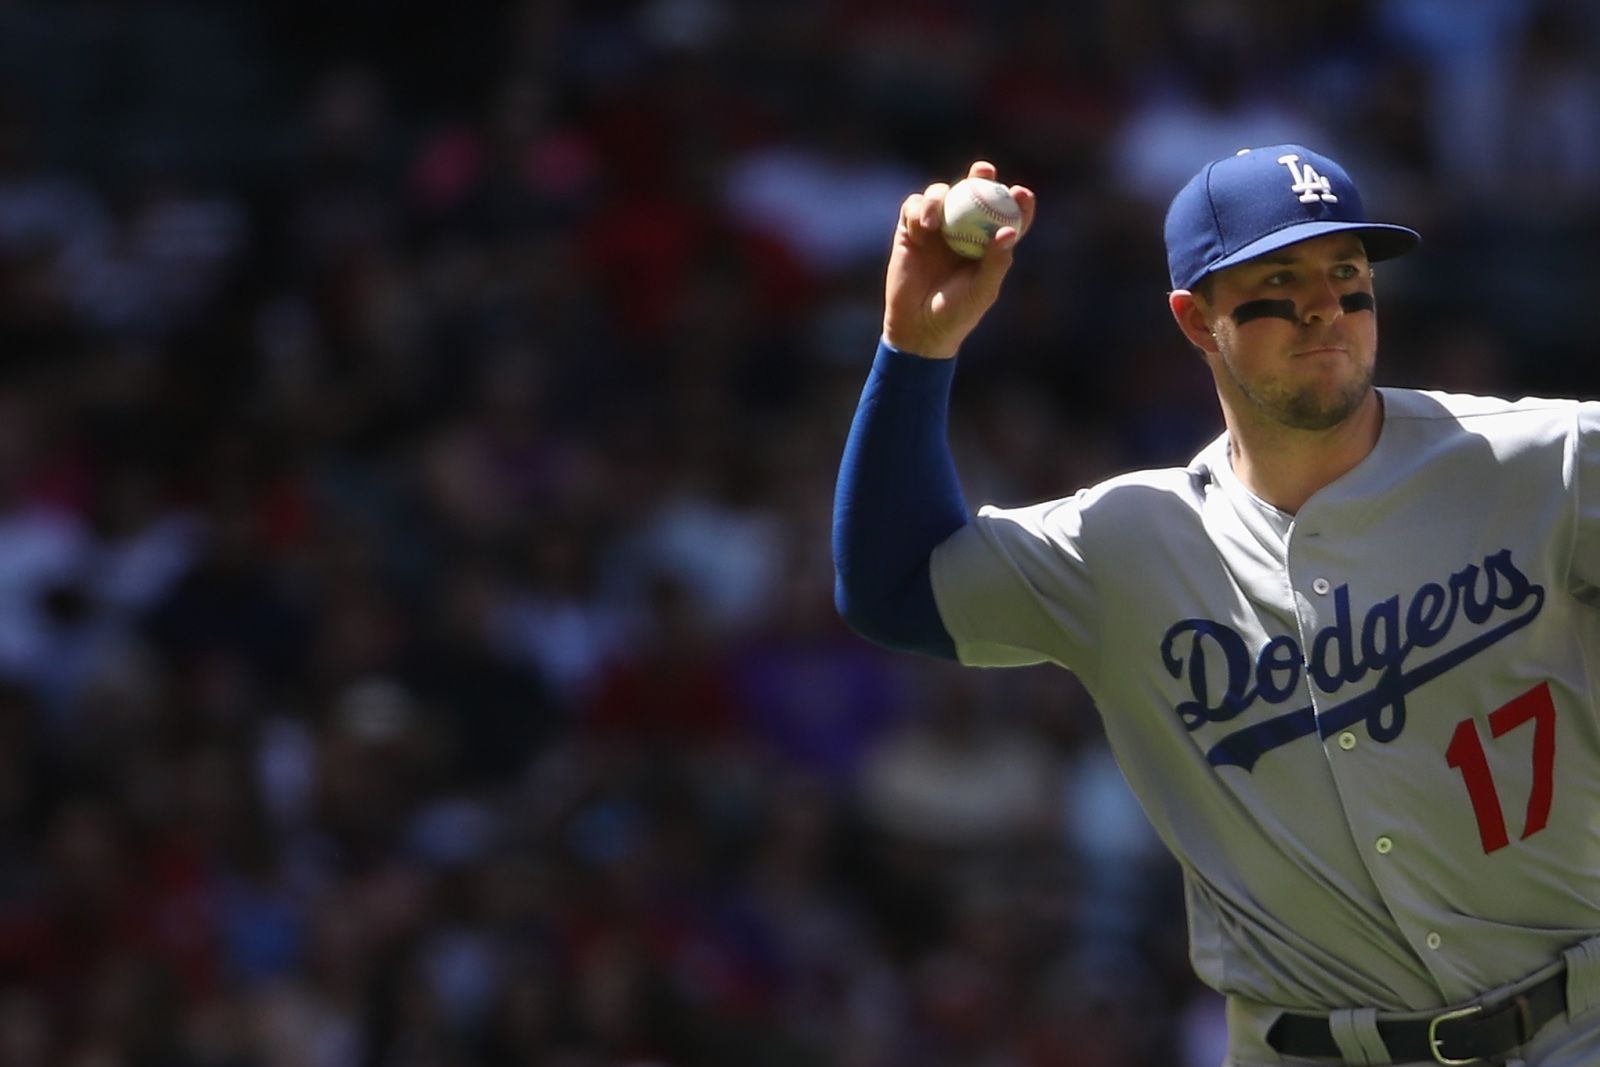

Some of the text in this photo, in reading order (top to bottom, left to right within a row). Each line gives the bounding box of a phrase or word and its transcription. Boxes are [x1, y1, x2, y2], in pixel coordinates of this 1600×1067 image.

[1277, 154, 1339, 204] LA
[1160, 548, 1544, 744] Dodgers
[1445, 680, 1556, 855] 17
